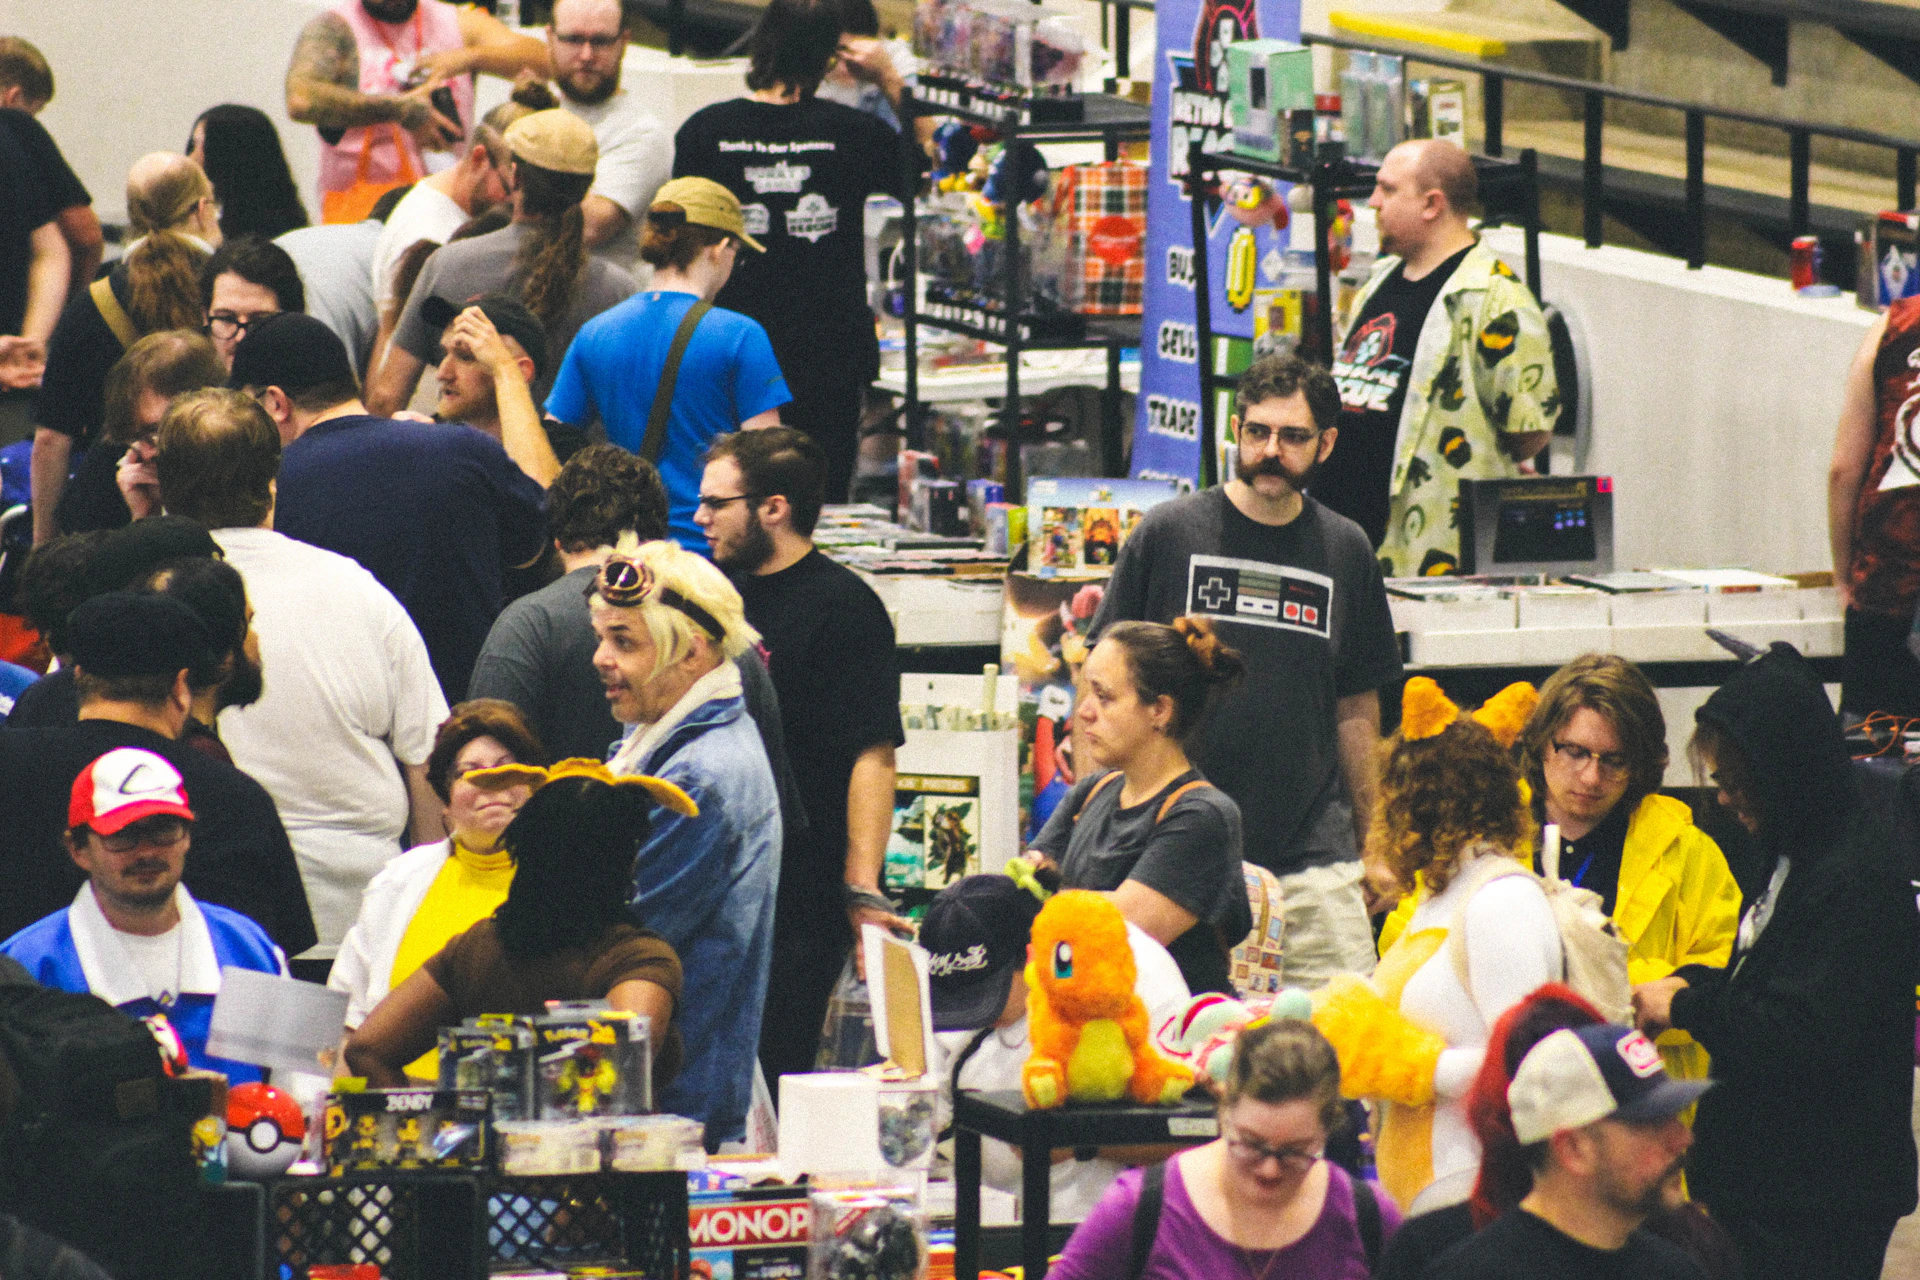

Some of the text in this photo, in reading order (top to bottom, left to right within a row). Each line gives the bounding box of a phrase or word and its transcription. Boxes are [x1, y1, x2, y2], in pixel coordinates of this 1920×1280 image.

[719, 140, 754, 152] Thanks
[754, 140, 767, 153] To
[1161, 326, 1195, 359] SELL
[1149, 399, 1198, 436] TRADE
